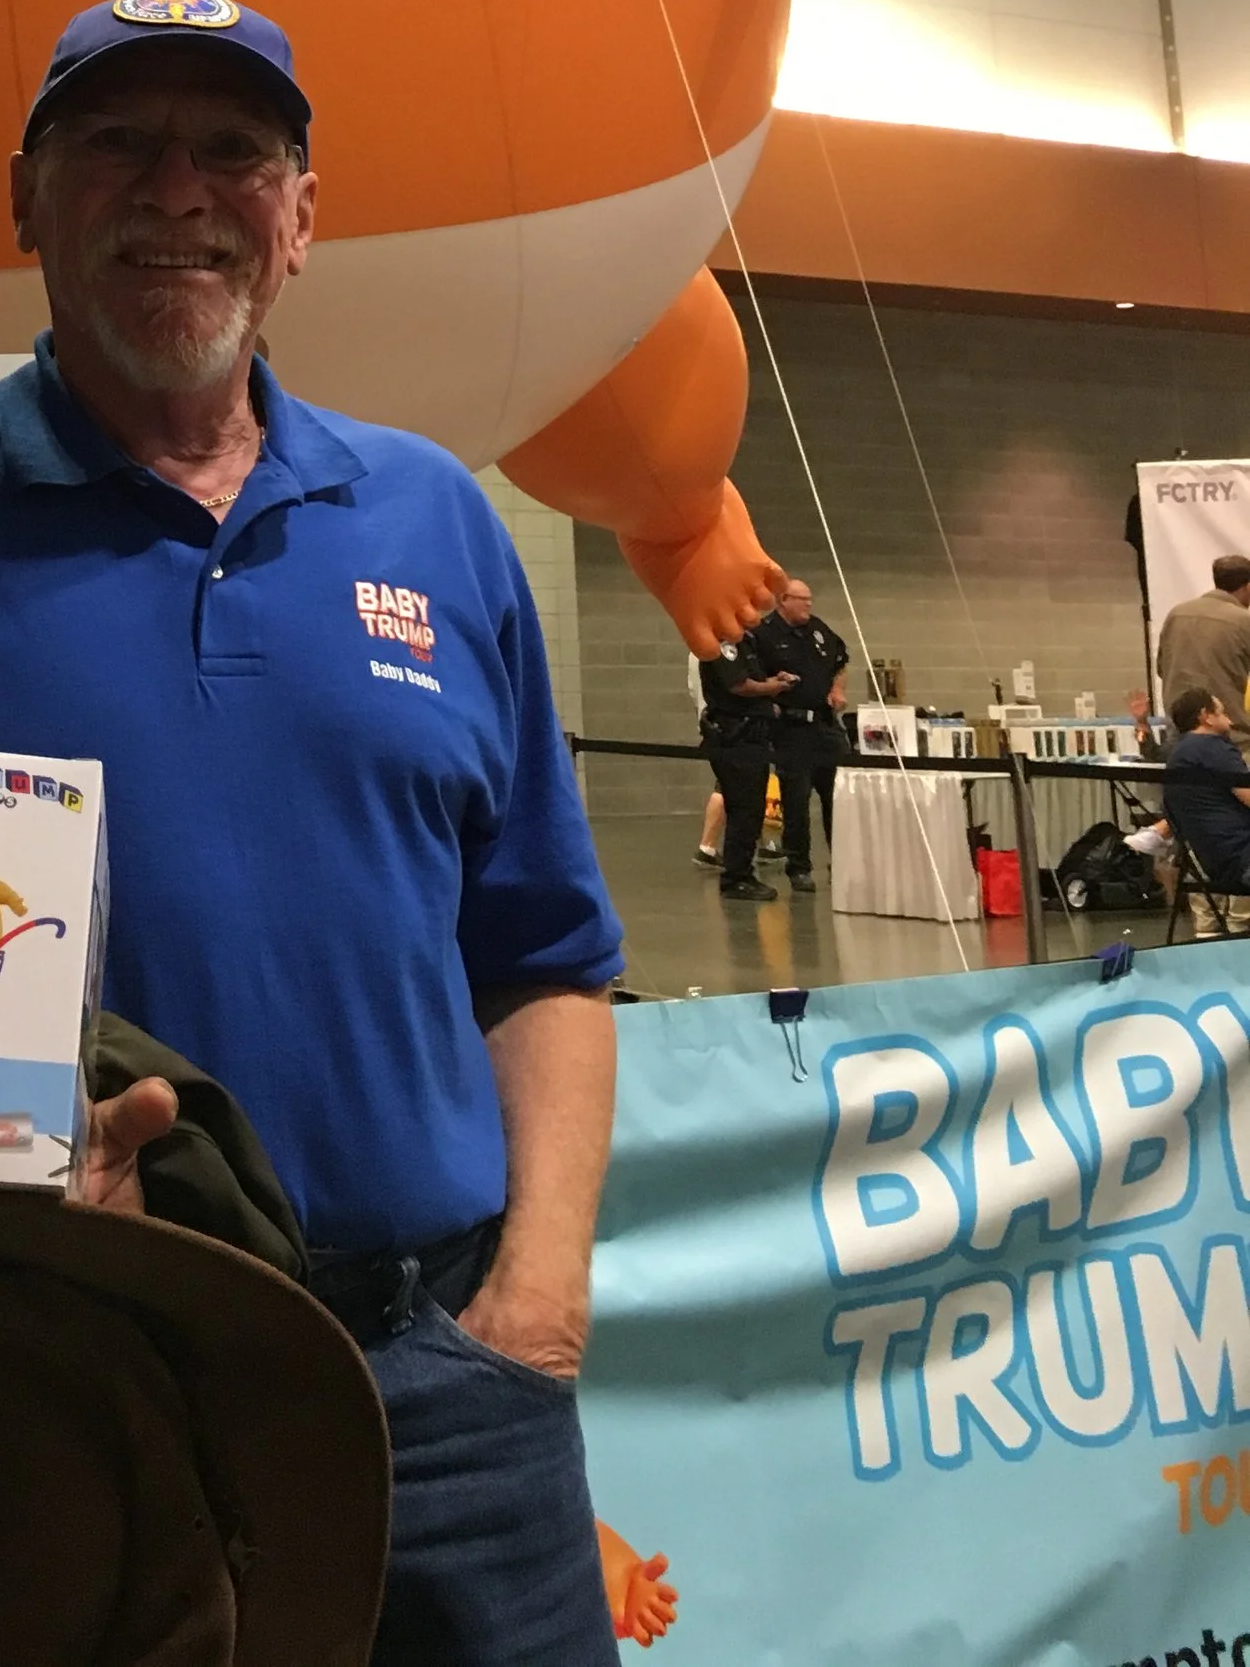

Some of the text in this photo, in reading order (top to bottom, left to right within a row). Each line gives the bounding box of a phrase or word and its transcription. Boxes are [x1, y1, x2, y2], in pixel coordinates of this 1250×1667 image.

[354, 581, 429, 625] BABY
[359, 612, 435, 651] TRUMP
[370, 659, 442, 694] Baby Daddy
